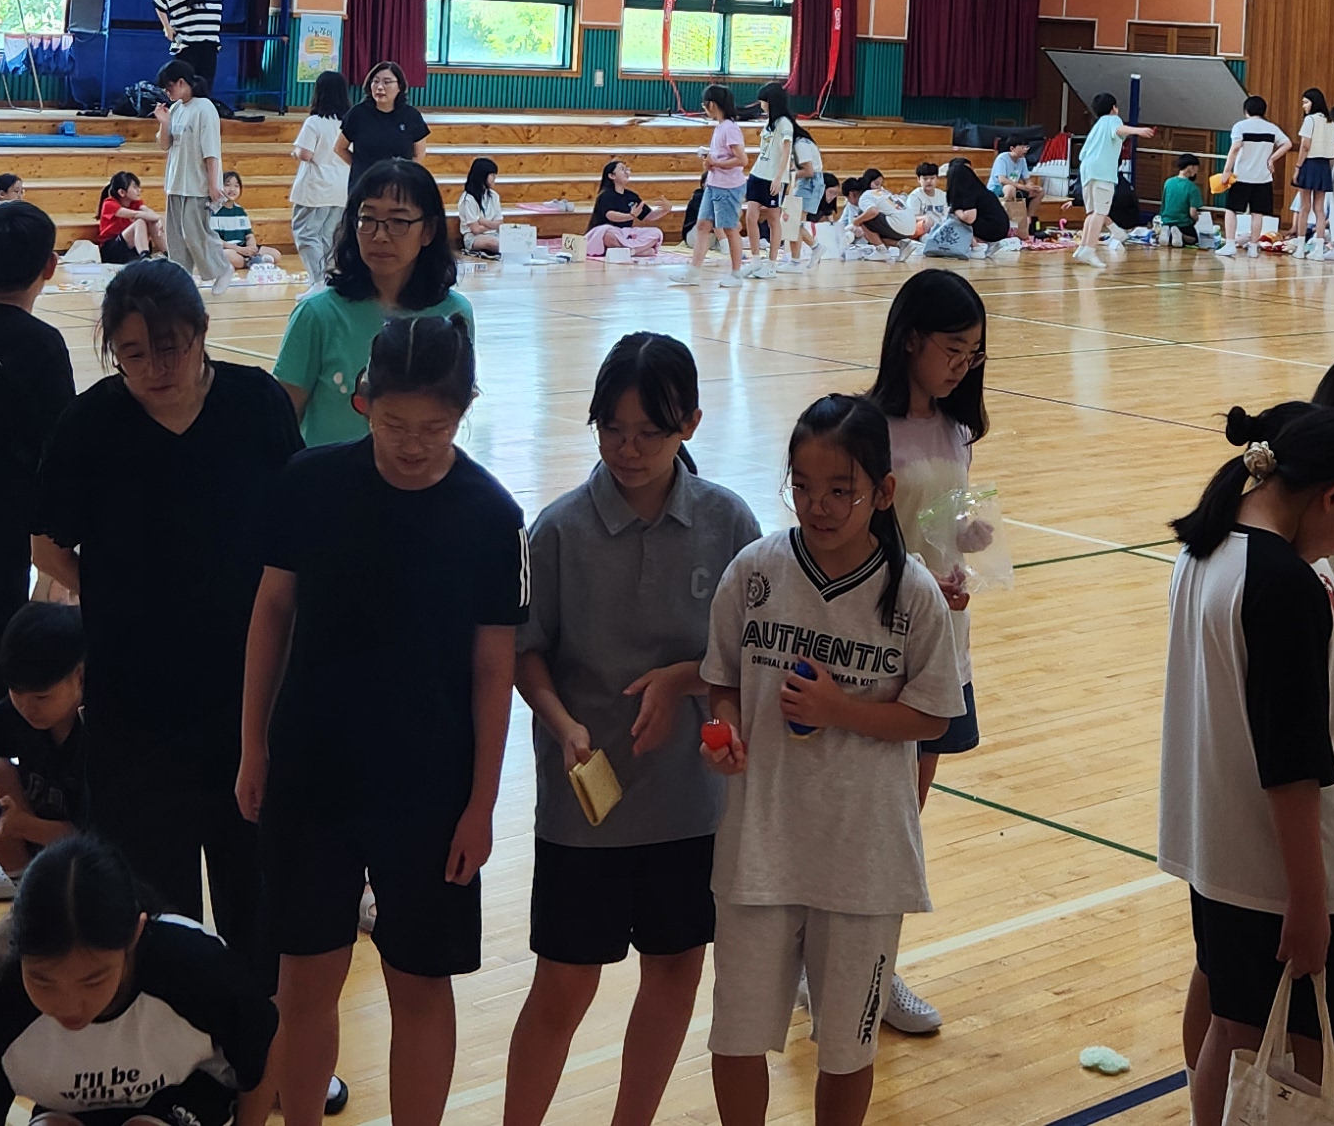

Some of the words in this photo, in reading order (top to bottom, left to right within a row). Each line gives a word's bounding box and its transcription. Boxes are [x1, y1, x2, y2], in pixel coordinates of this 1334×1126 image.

[691, 567, 710, 599] C
[741, 619, 902, 674] AUTHENTIC
[74, 1071, 104, 1089] I'll
[111, 1066, 140, 1086] be
[59, 1086, 114, 1100] with
